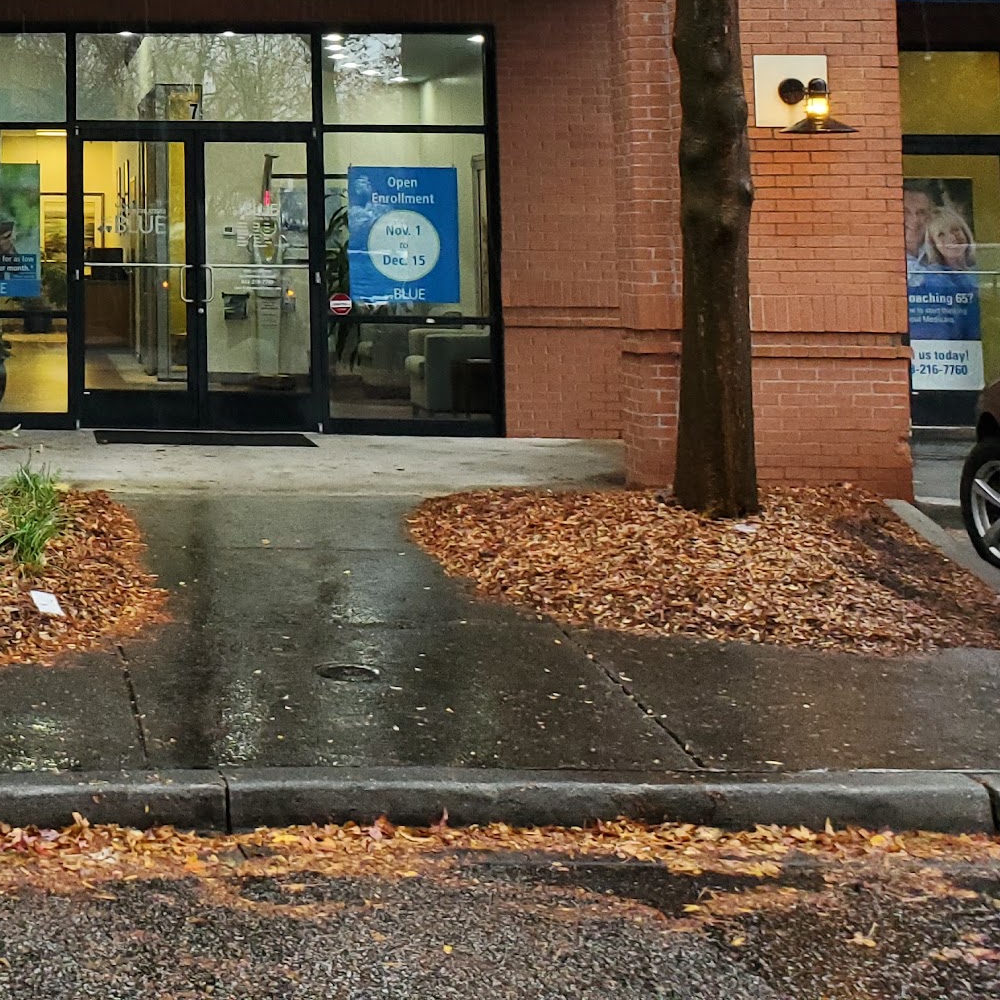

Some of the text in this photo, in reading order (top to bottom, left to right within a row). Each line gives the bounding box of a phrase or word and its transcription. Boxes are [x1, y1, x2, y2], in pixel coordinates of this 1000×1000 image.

[189, 103, 198, 120] 7
[387, 176, 418, 190] Open
[371, 192, 435, 204] Enrollment
[385, 225, 421, 236] Nov. 1
[383, 254, 426, 266] Dec. 15
[393, 288, 426, 300] BLUE
[908, 293, 974, 306] oaching 65?
[918, 351, 932, 360] us
[934, 350, 969, 363] today!
